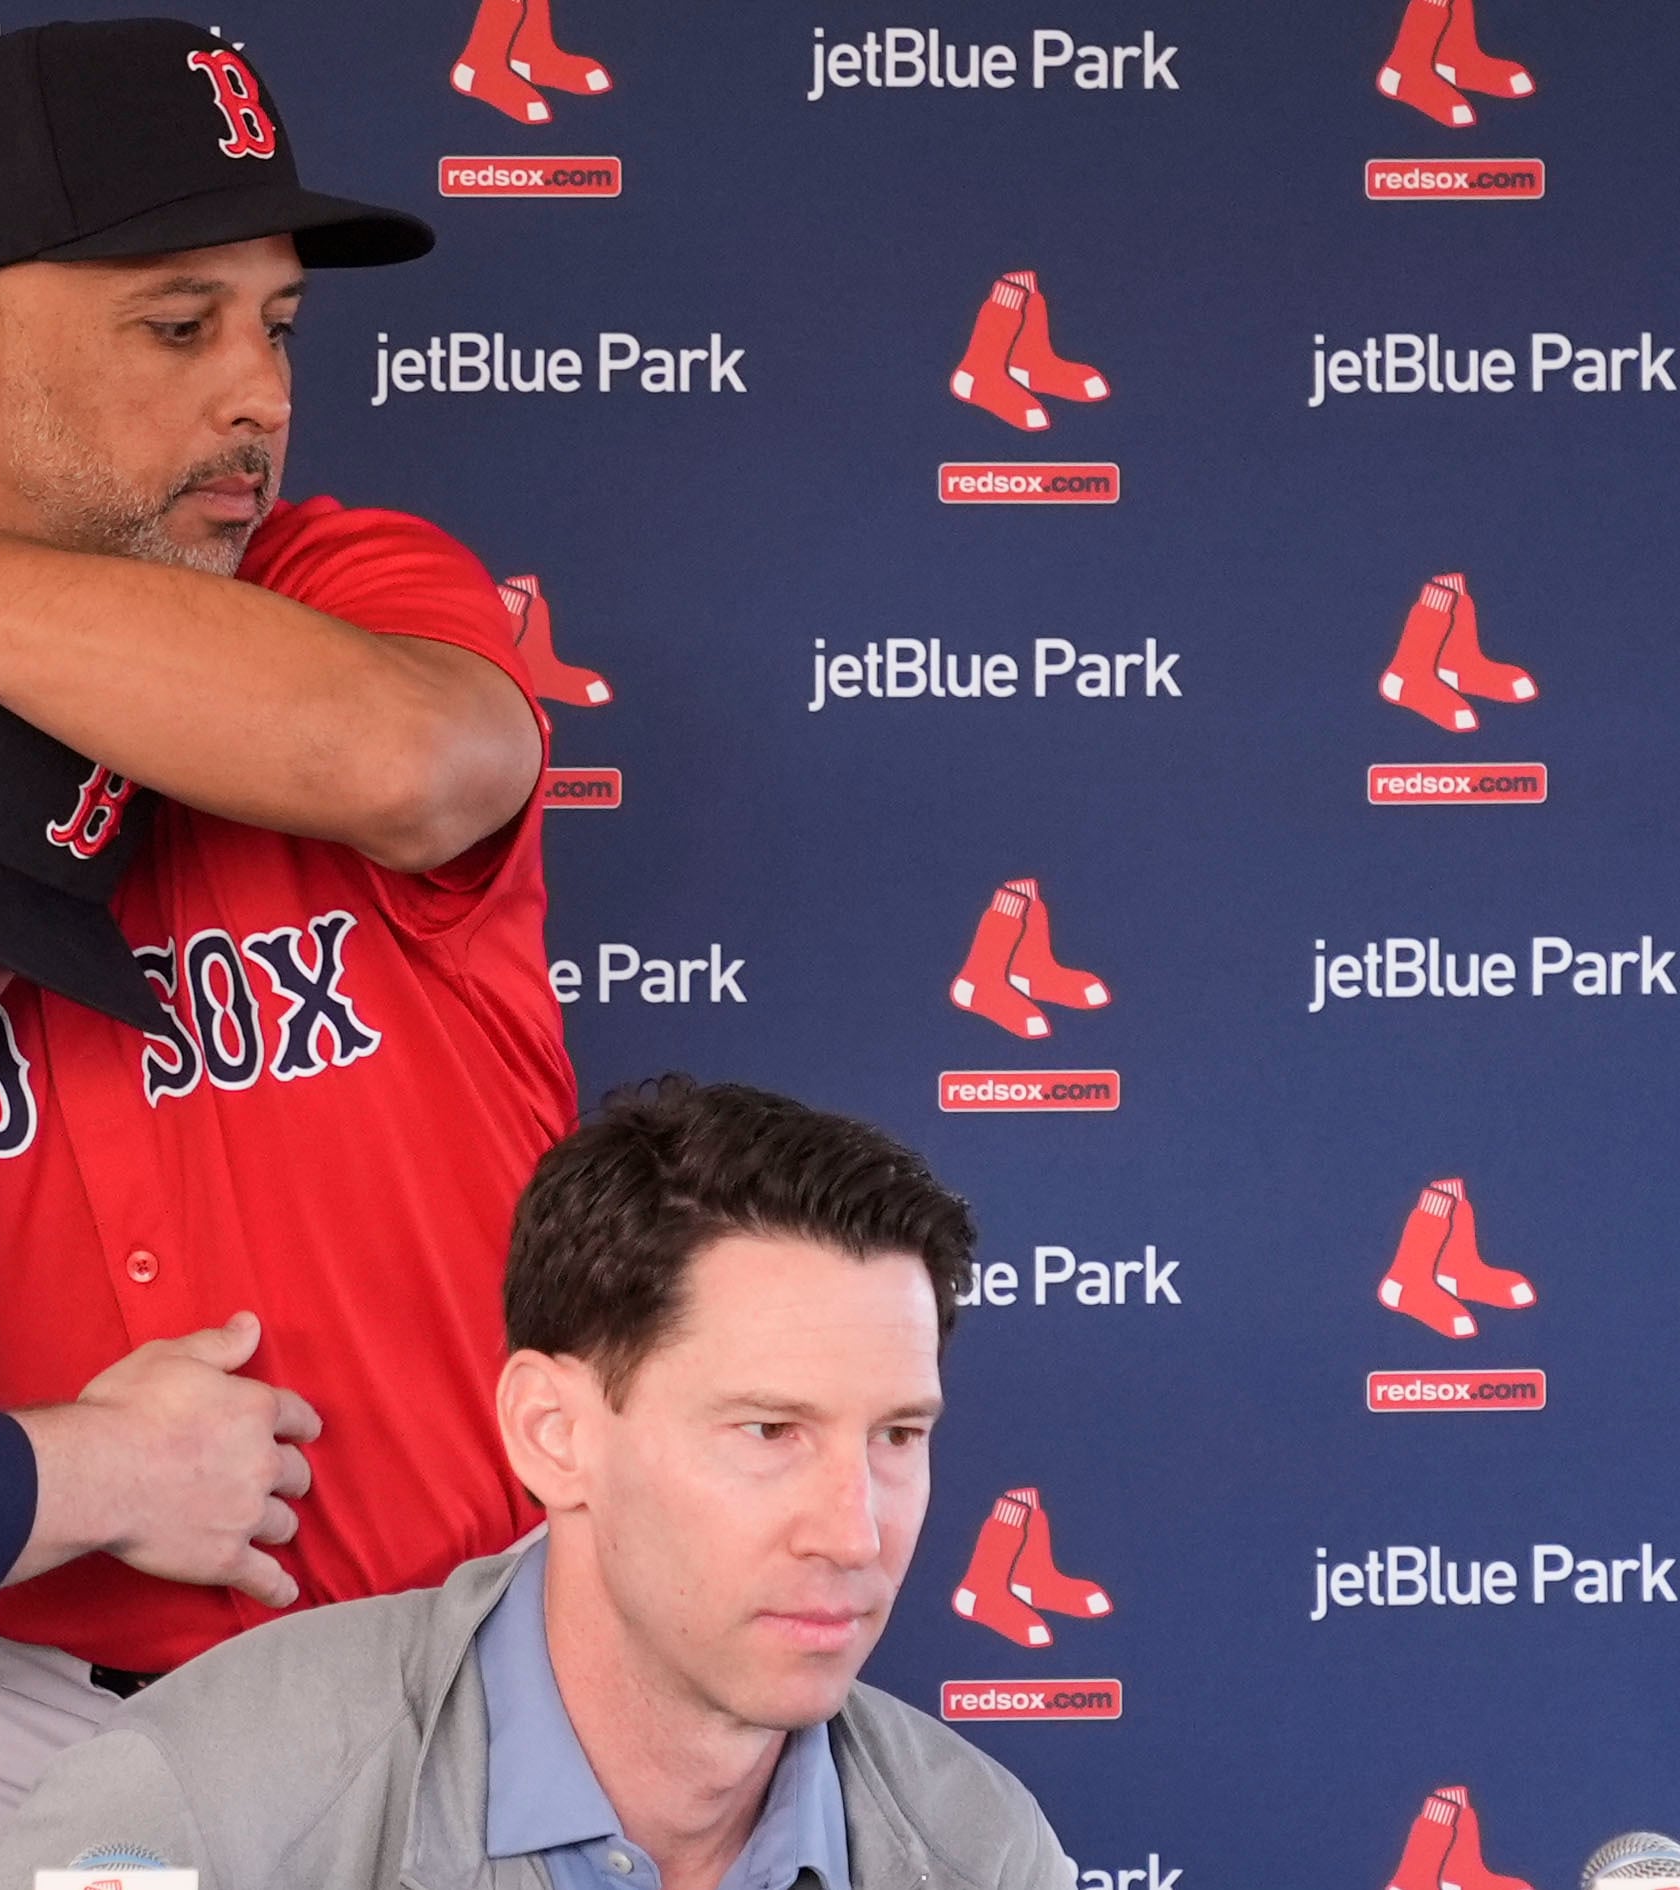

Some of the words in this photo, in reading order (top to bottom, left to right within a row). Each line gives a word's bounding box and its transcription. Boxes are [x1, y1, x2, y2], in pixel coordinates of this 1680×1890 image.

[807, 27, 1017, 101] jetBlue
[1033, 29, 1180, 90] Park
[187, 49, 276, 159] B
[448, 164, 612, 187] redsox.com
[1374, 167, 1536, 189] redsox.com
[371, 332, 583, 406] jetBlue
[599, 332, 747, 393] Park
[1308, 333, 1516, 408] jetBlue
[1531, 332, 1677, 393] Park
[948, 471, 1110, 493] redsox.com
[807, 637, 1019, 712] jetBlue
[1034, 637, 1183, 698] Park
[1377, 772, 1538, 794] redsox.com
[598, 943, 748, 1003] Park
[1308, 937, 1516, 1013] jetBlue
[1531, 935, 1677, 996] Park
[132, 909, 383, 1109] SOX
[947, 1079, 1110, 1101] redsox.com
[1034, 1244, 1182, 1306] Park
[1376, 1379, 1537, 1401] redsox.com
[1310, 1545, 1518, 1621] jetBlue
[1532, 1542, 1678, 1604] Park
[950, 1689, 1113, 1711] redsox.com
